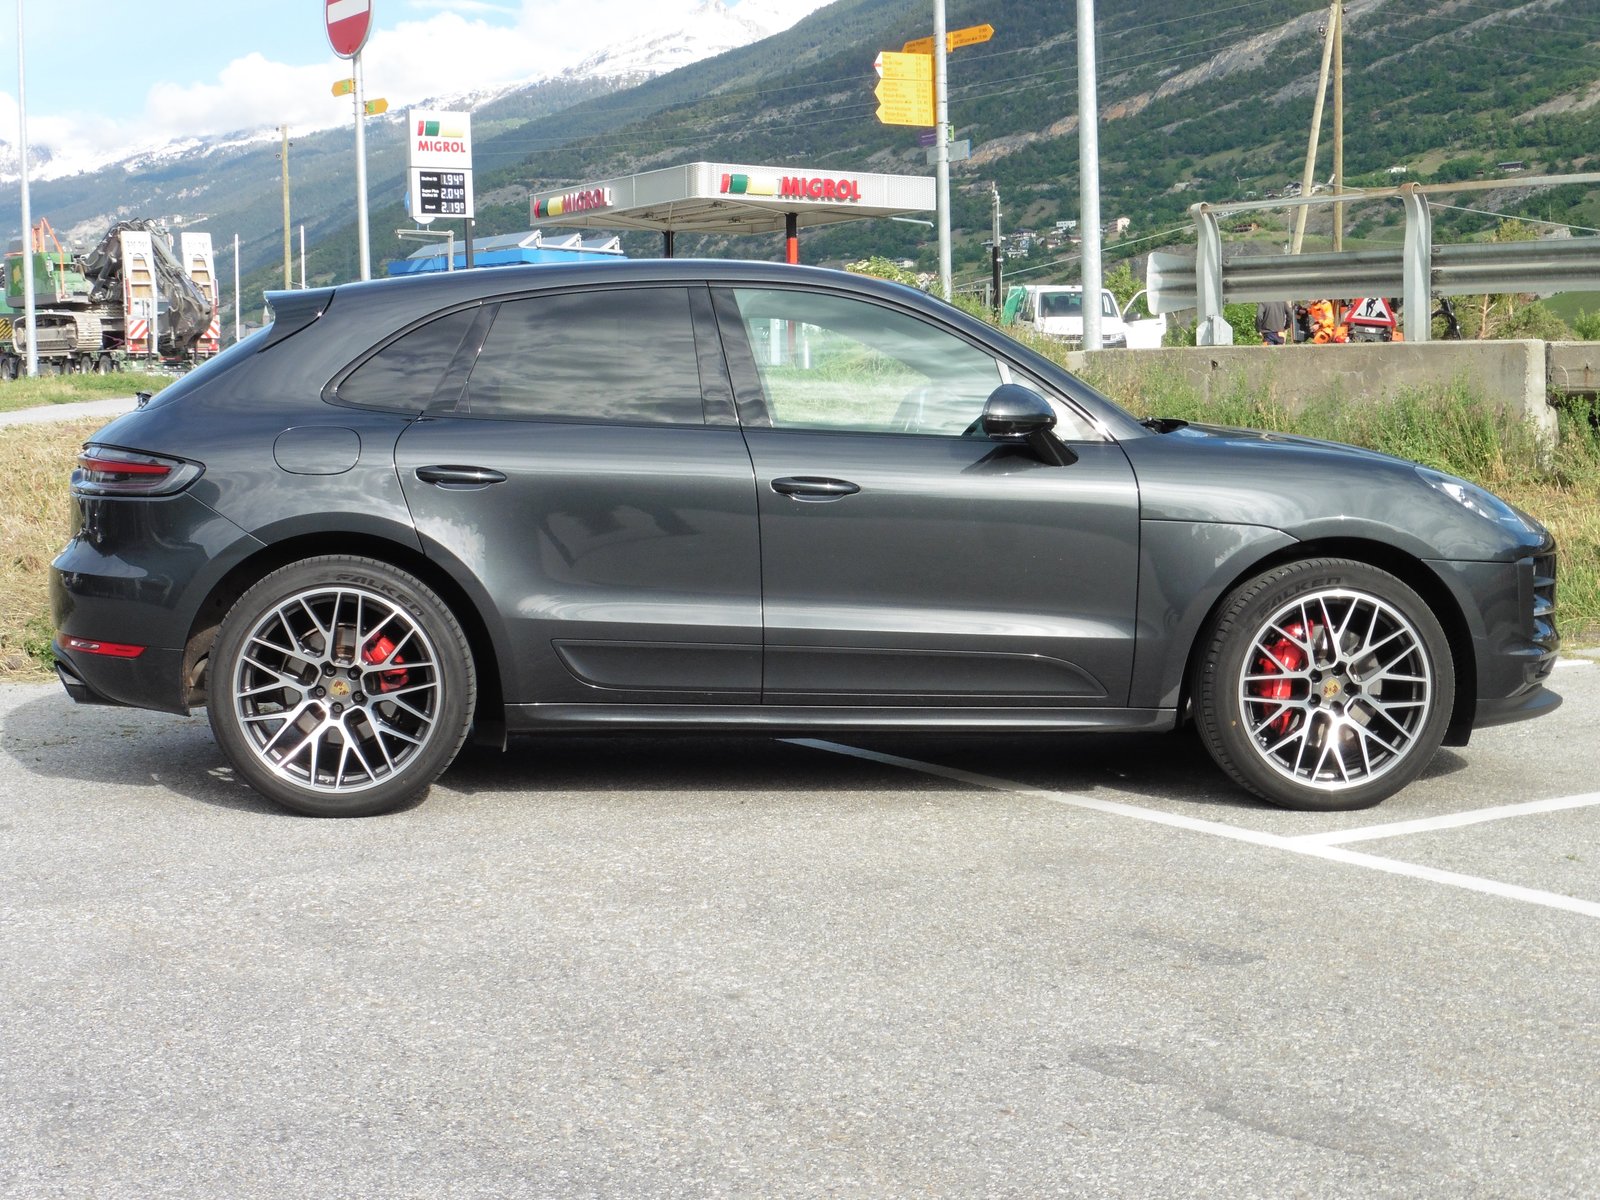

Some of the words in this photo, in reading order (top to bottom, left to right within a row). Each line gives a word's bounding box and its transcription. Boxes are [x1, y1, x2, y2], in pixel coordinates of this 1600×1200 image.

[418, 140, 466, 153] MIGROL
[563, 187, 613, 214] MIGROL
[780, 176, 861, 201] MIGROL
[336, 573, 424, 617] FALKEN
